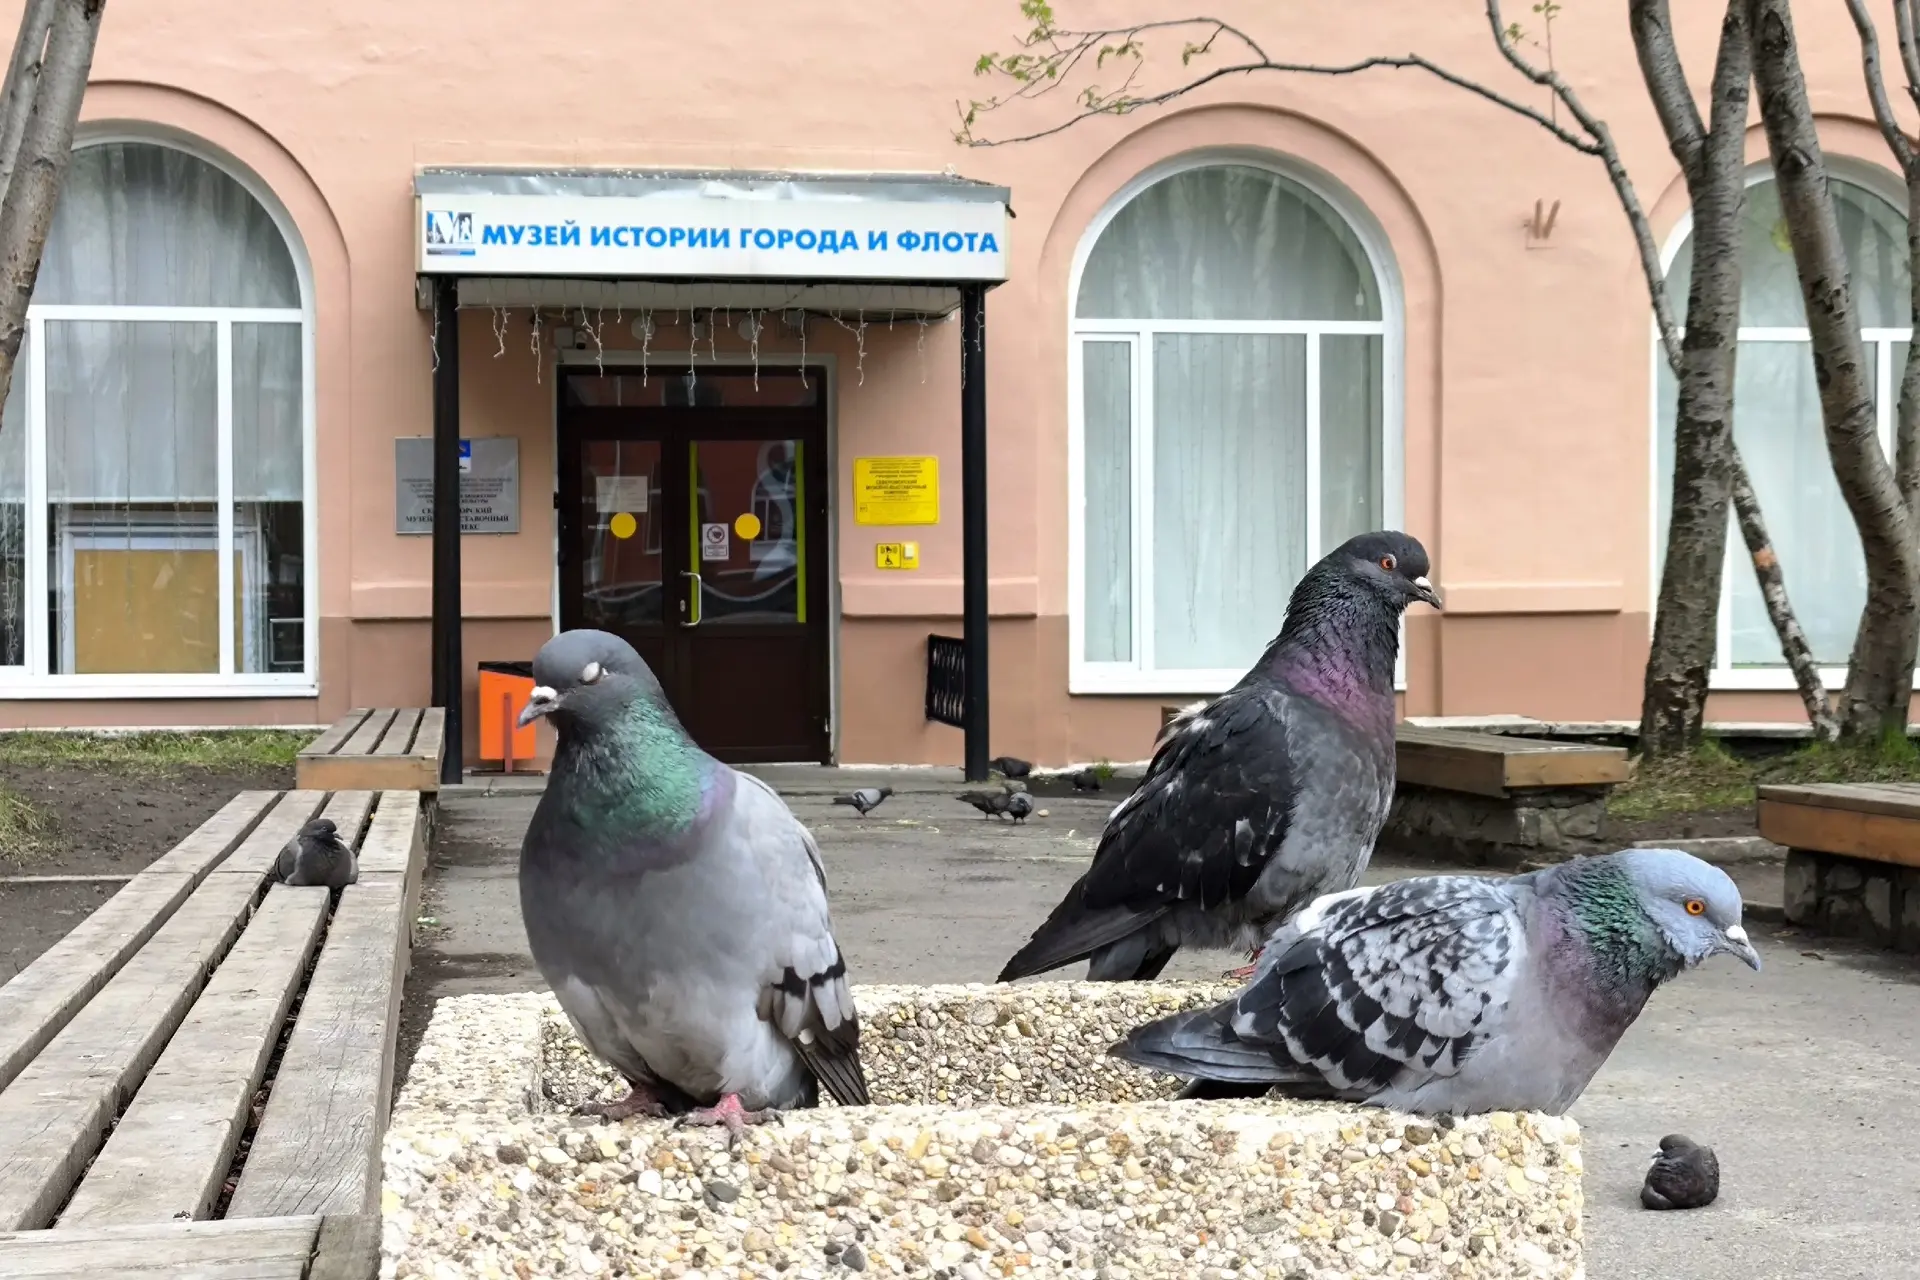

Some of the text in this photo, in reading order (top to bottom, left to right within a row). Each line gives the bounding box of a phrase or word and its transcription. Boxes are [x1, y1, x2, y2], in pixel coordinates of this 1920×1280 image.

[481, 219, 999, 255] МУЗЕЙ ИСТОРИИ ГОРОДА И ФЛОТА
